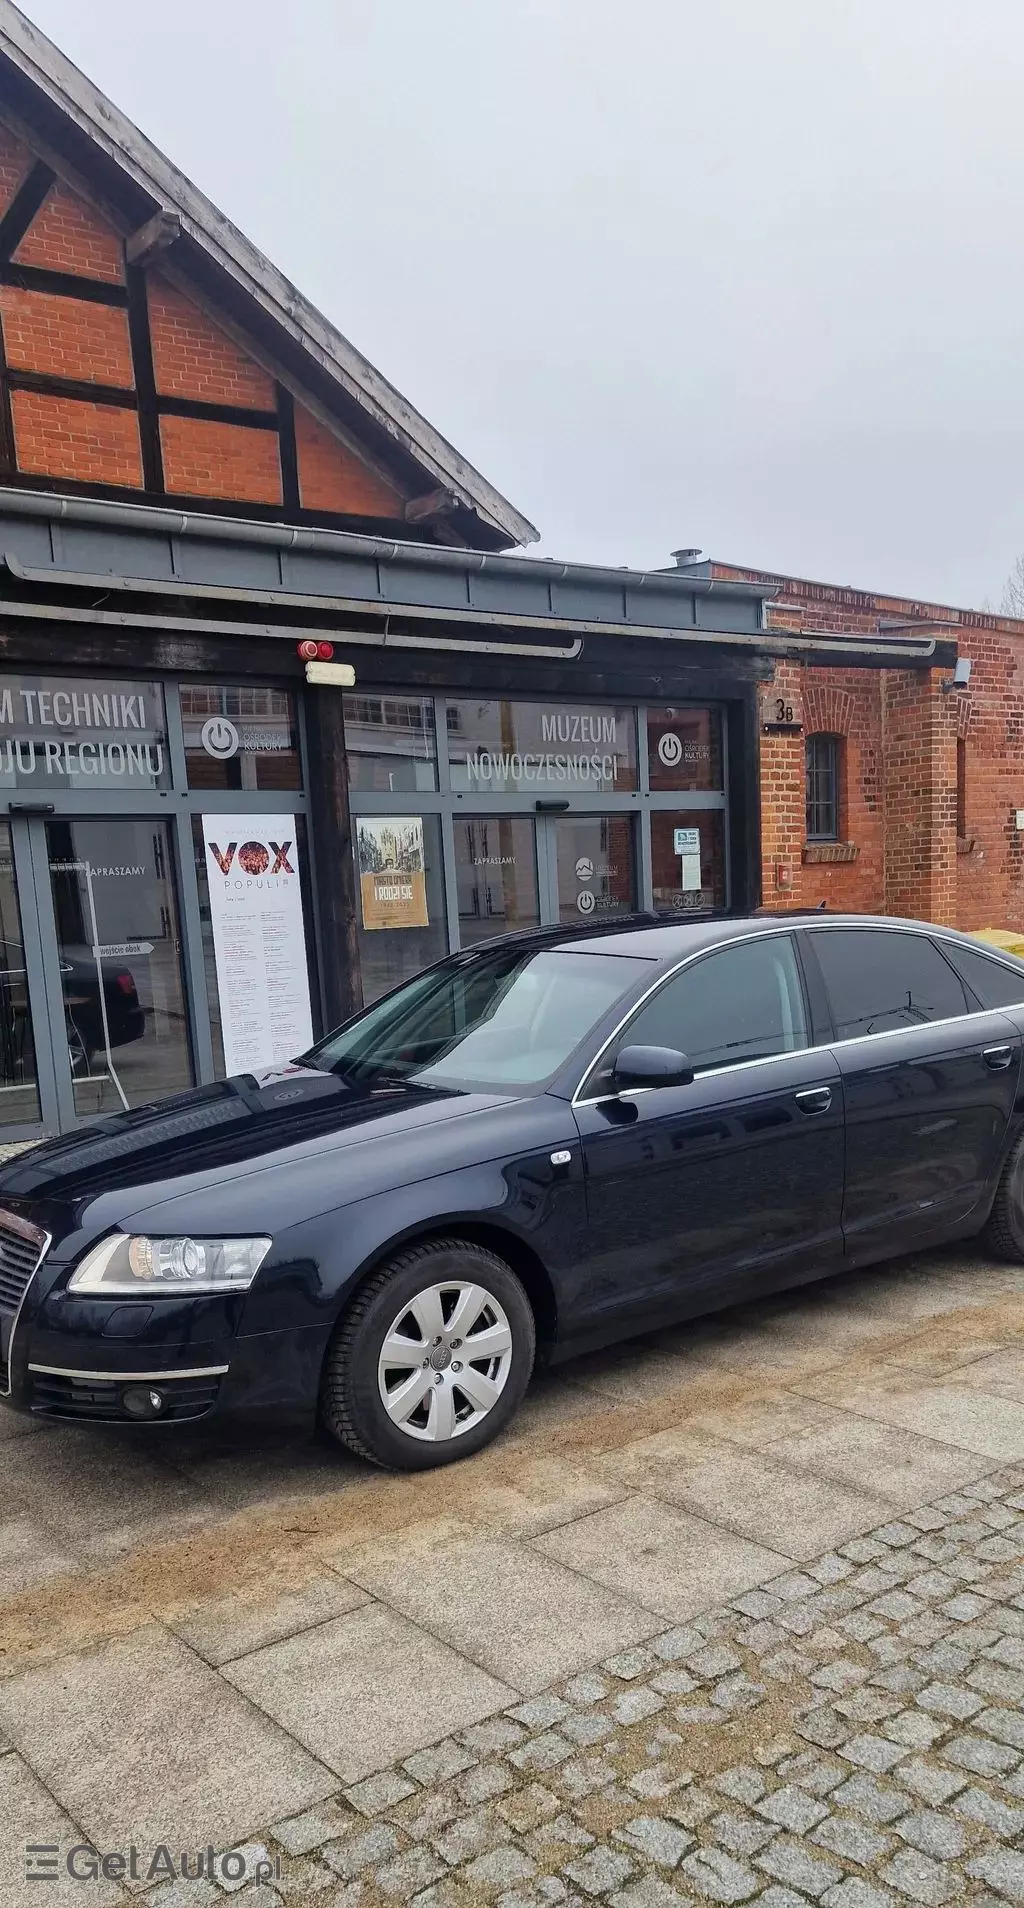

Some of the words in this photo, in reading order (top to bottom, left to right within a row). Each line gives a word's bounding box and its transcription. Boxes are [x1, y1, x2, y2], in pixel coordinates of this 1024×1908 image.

[20, 690, 146, 728] TECHNIKI
[541, 715, 616, 743] MUZEUM
[0, 739, 36, 774] JU
[44, 740, 164, 776] REGIONU
[243, 741, 281, 751] KULTURY
[466, 748, 618, 781] NOWOCZESNOŚCI
[207, 841, 296, 876] VOX
[224, 880, 279, 890] POPULI
